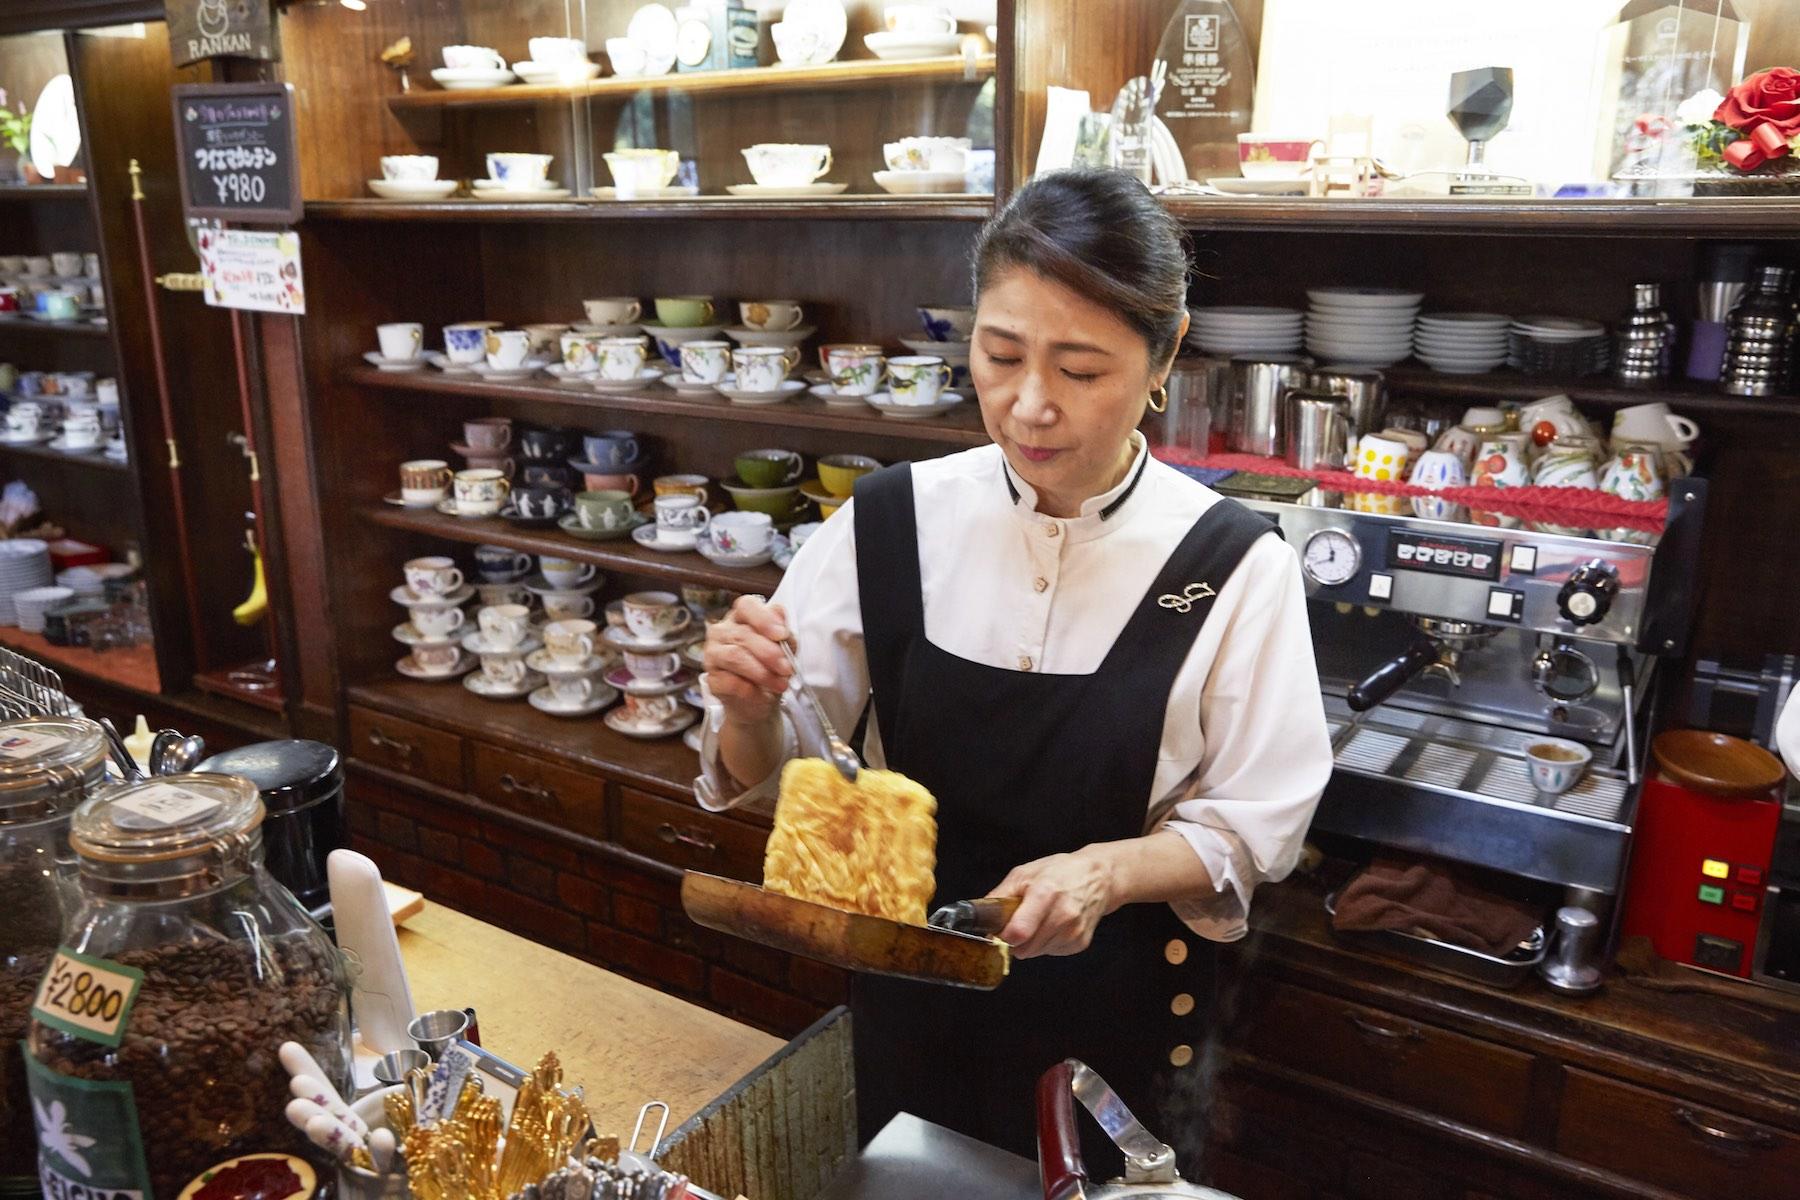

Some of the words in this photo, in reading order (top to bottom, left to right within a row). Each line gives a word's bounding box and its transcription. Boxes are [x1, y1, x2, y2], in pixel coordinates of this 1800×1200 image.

[187, 32, 252, 60] RANKAN
[212, 173, 266, 204] ¥980
[42, 958, 123, 1022] ¥2800
